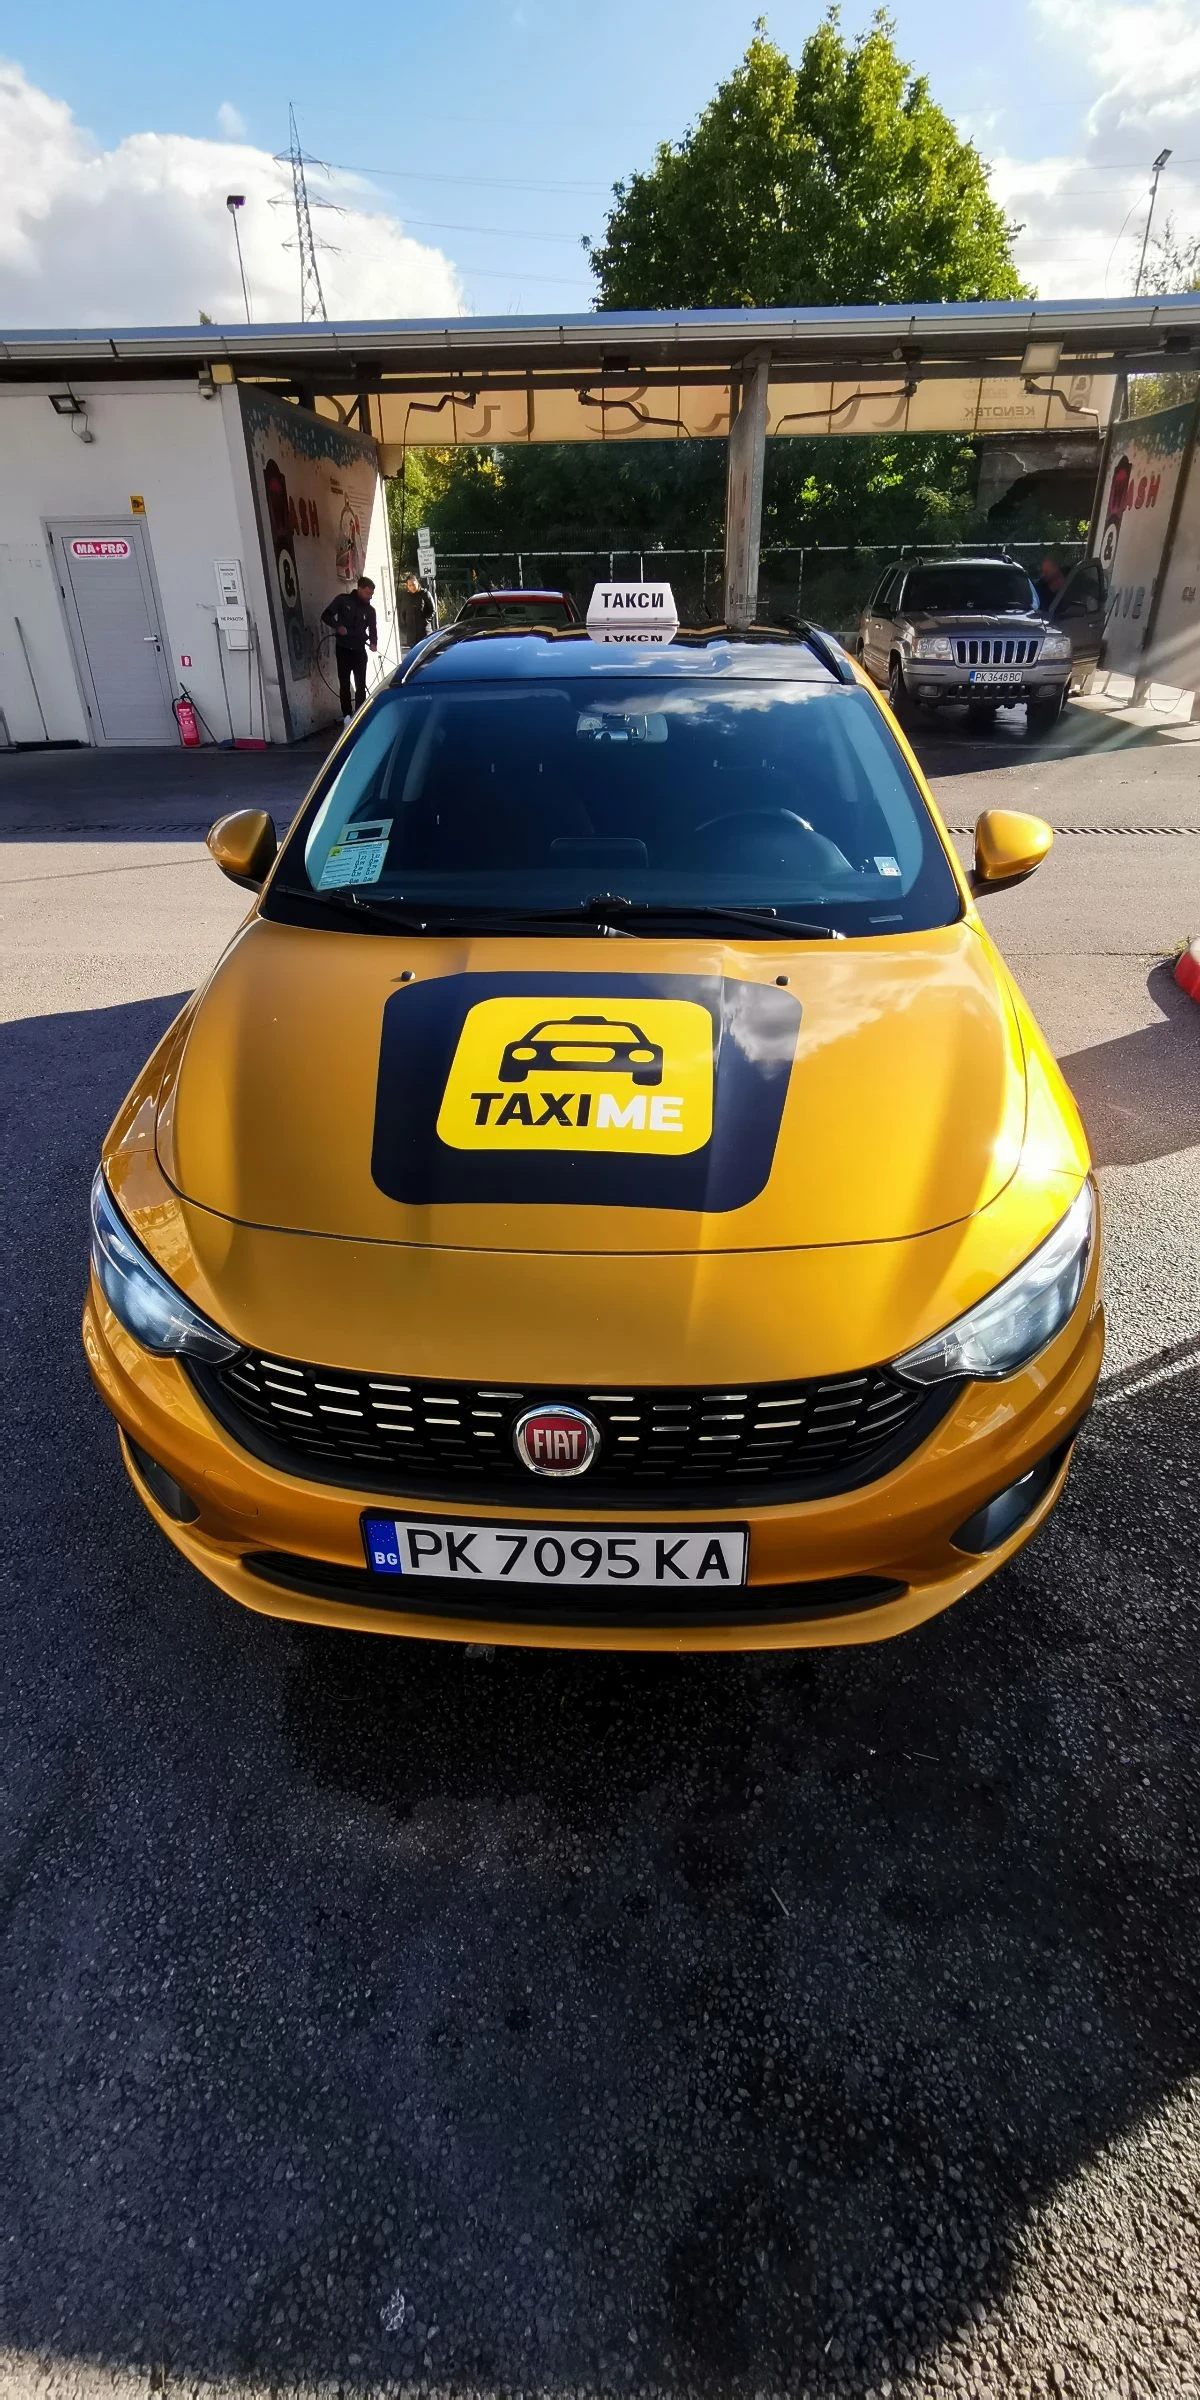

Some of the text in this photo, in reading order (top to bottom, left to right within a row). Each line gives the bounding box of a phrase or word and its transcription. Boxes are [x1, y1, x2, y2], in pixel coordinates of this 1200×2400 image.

[601, 592, 664, 608] ТАКСИ
[533, 1428, 582, 1460] FIAT
[374, 1551, 398, 1566] BG
[406, 1528, 730, 1580] PK 7095 KA
